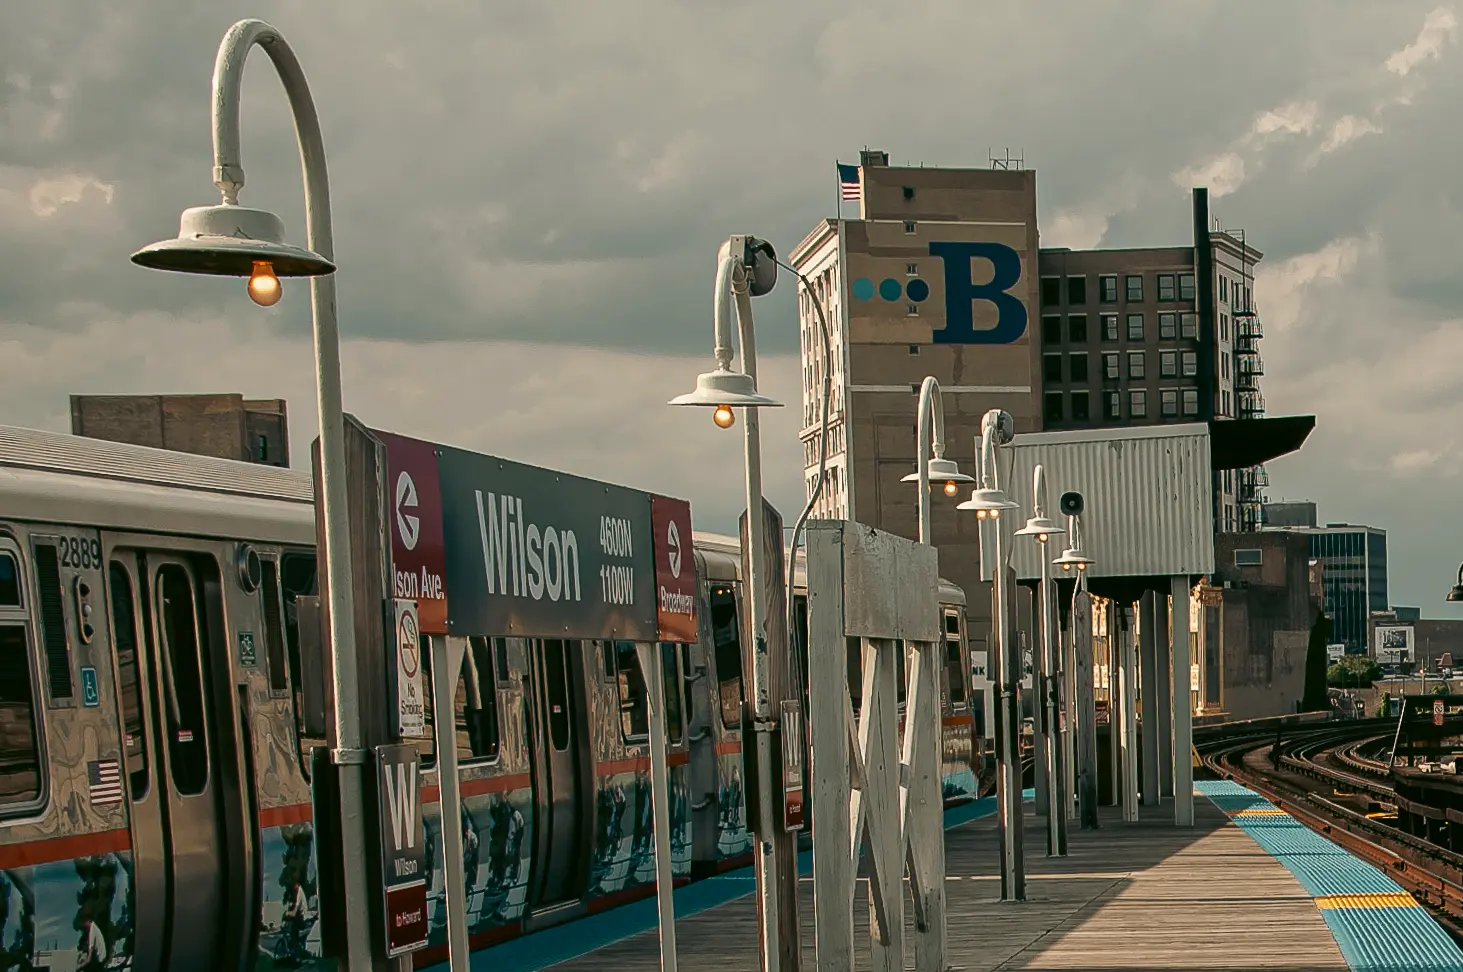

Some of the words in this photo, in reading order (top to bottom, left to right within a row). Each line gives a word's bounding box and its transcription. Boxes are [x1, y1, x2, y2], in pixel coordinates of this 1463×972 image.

[928, 241, 1028, 345] B
[60, 535, 102, 570] 2889
[474, 489, 581, 602] Wilson
[600, 515, 632, 558] 4600N
[392, 562, 419, 598] lson
[420, 565, 445, 600] Ave.
[599, 563, 633, 605] 1100W
[660, 585, 694, 621] Broadway
[384, 761, 417, 851] W
